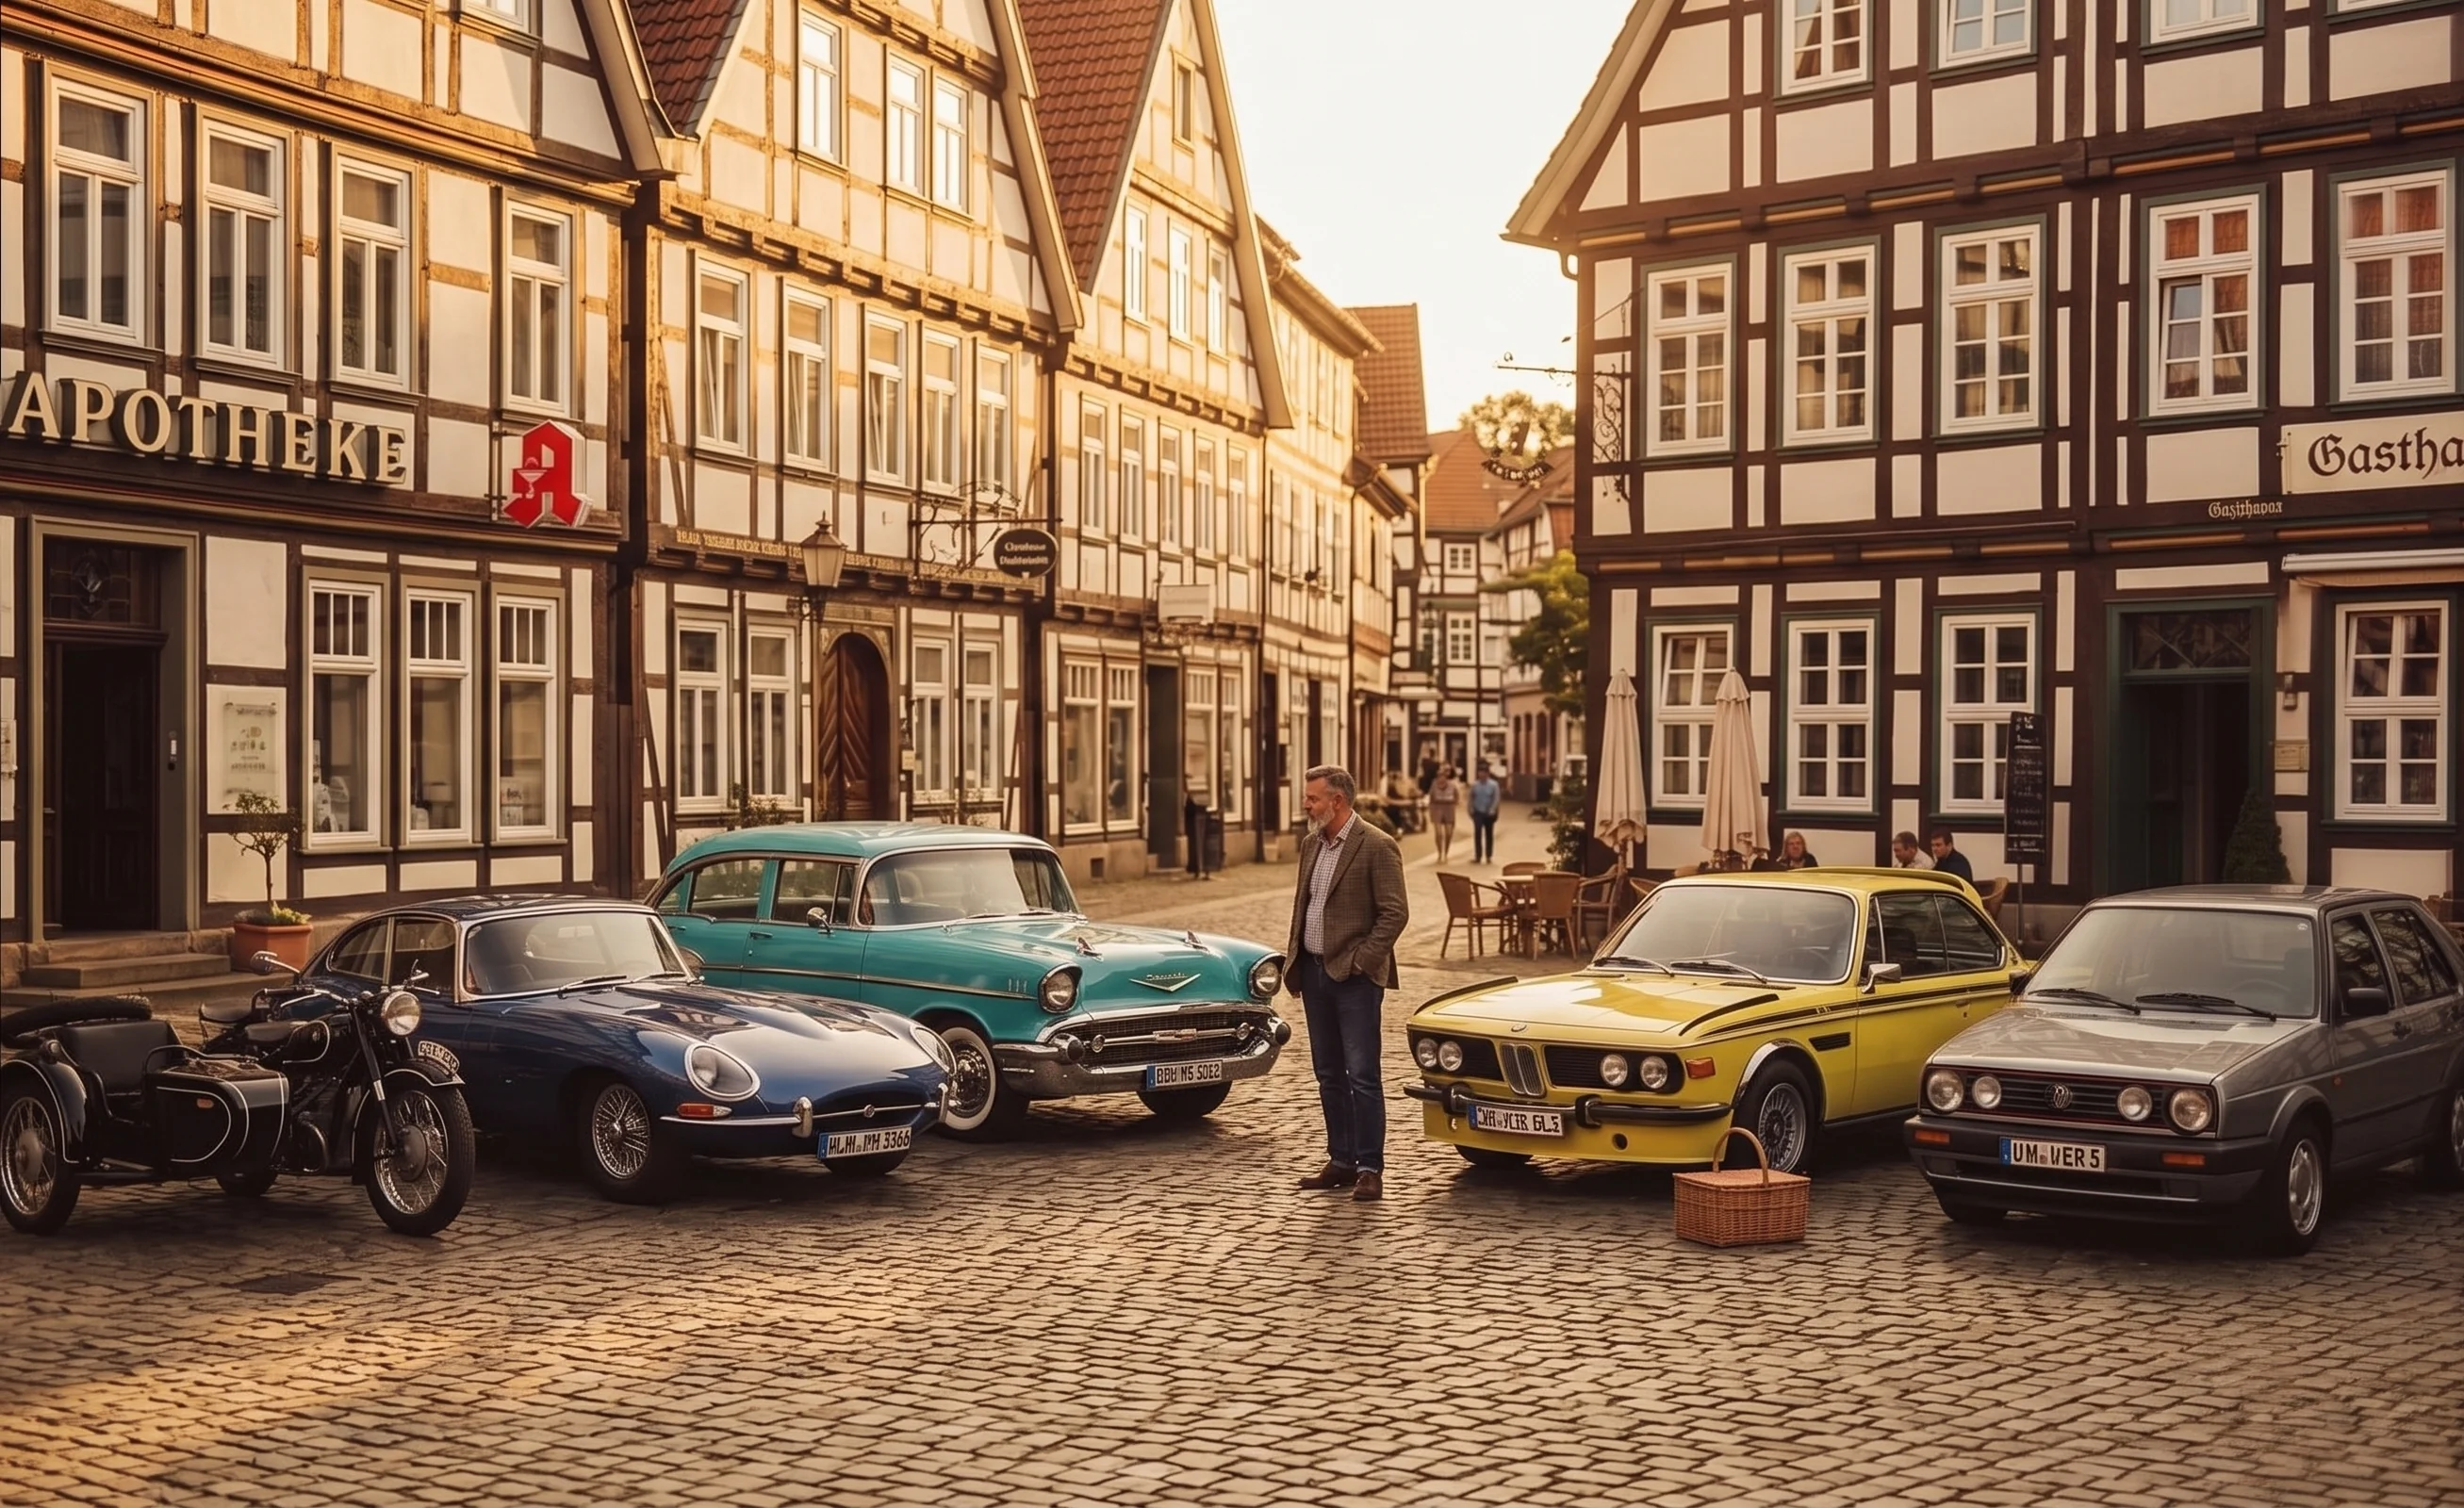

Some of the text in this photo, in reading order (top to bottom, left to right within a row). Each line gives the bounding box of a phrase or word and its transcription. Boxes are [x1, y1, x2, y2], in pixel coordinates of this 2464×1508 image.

[8, 371, 406, 484] APOTHEKE
[2308, 427, 2464, 480] Gastha
[2012, 1142, 2038, 1164] UM
[2089, 1148, 2100, 1169] 5
